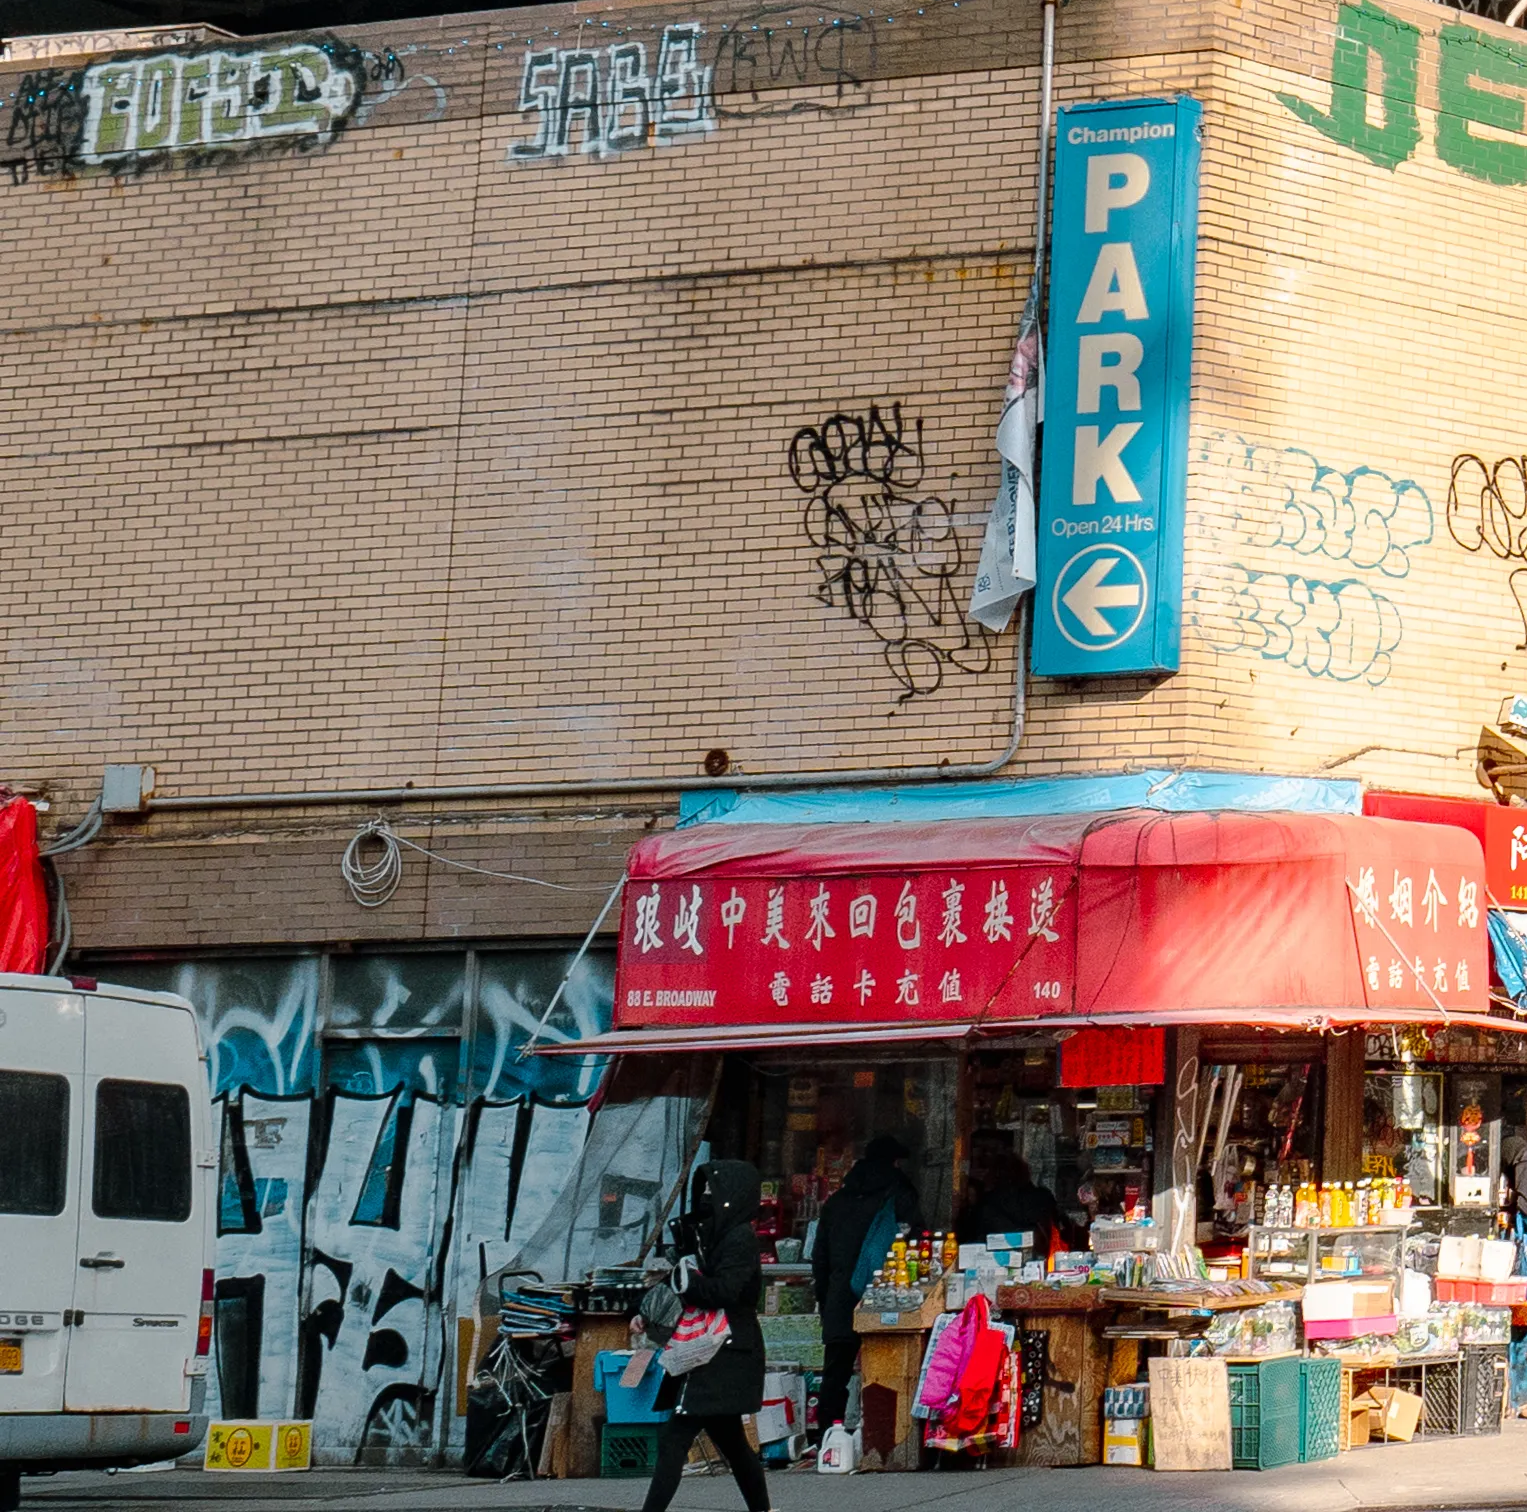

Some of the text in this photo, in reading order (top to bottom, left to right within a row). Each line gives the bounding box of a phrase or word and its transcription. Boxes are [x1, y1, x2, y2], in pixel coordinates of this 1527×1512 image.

[1067, 120, 1176, 147] Champion
[1072, 152, 1151, 506] PARK
[1051, 514, 1155, 540] Open 24 Hrs.
[655, 989, 717, 1008] BROADWAY
[767, 967, 963, 1007] 電話卡充值
[1032, 980, 1061, 1000] 140
